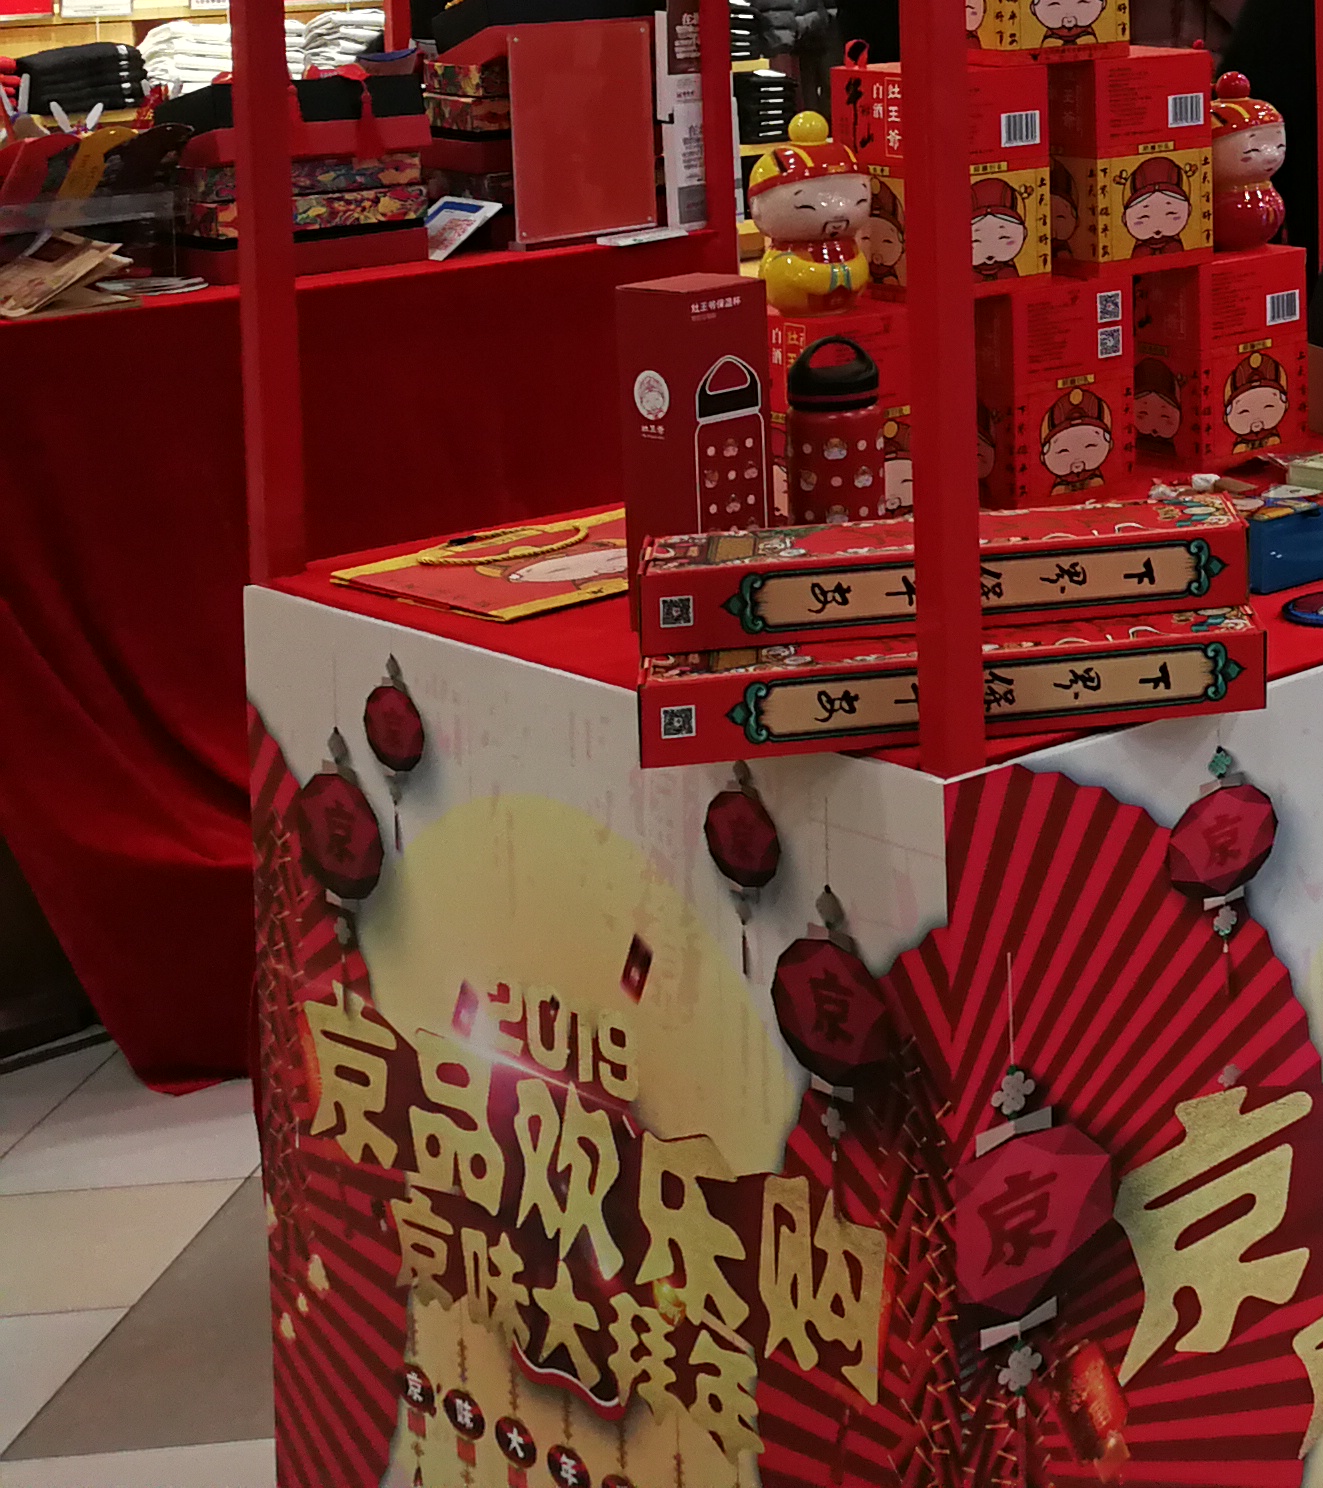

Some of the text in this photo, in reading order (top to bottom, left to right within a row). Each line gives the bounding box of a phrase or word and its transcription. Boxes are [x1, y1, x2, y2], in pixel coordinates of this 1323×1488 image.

[1202, 812, 1246, 871] 京
[486, 979, 638, 1102] 2019
[806, 967, 857, 1045] 京
[303, 980, 889, 1405] 京品欢乐购
[977, 1170, 1060, 1278] 京
[392, 1178, 766, 1459] 京味大拜年
